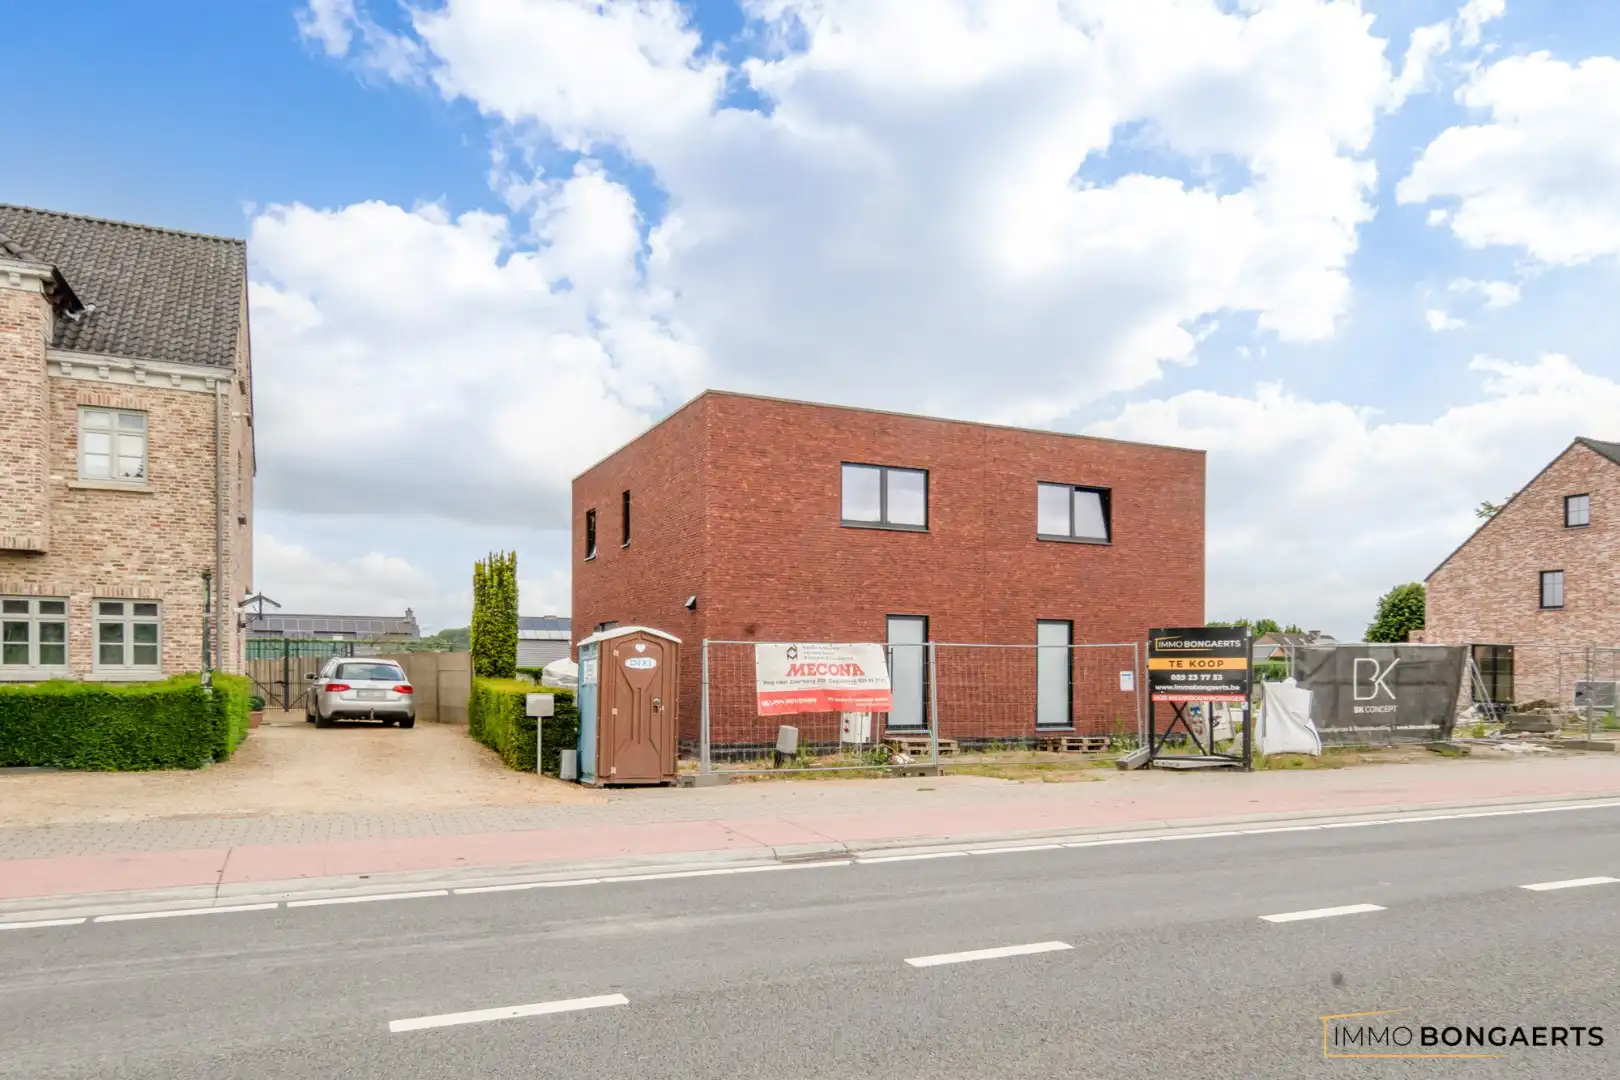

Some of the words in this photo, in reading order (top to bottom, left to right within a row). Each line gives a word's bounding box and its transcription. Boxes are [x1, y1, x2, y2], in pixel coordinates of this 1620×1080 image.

[1158, 640, 1183, 648] IMMO
[1184, 640, 1241, 648] BONGAERTS
[1168, 660, 1183, 668] TE
[1189, 660, 1224, 668] KOOP
[786, 663, 865, 676] MECONA
[1353, 658, 1400, 700] BK
[1353, 706, 1365, 714] BK
